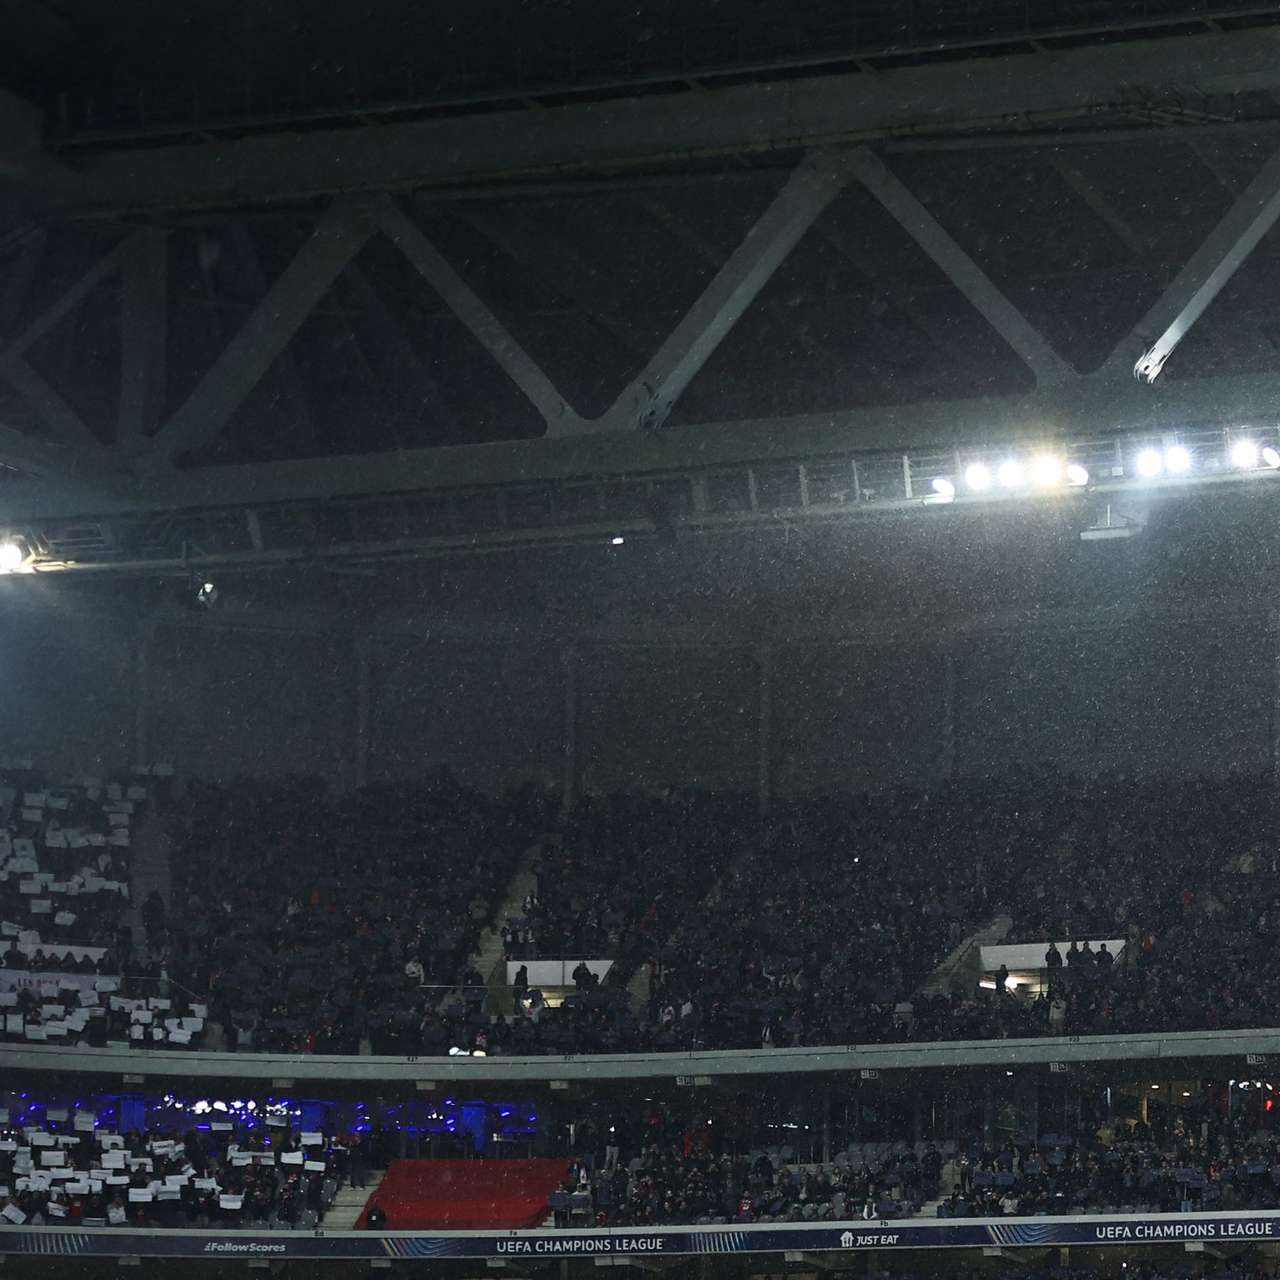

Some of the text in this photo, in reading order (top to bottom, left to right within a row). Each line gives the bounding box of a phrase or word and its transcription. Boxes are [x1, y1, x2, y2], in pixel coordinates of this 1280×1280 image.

[1095, 1222, 1273, 1239] UEFA CHAMPIONS LEAGUE
[496, 1238, 663, 1253] UEFA CHAMPIONS LEAGUE
[855, 1234, 899, 1247] JUST EAT
